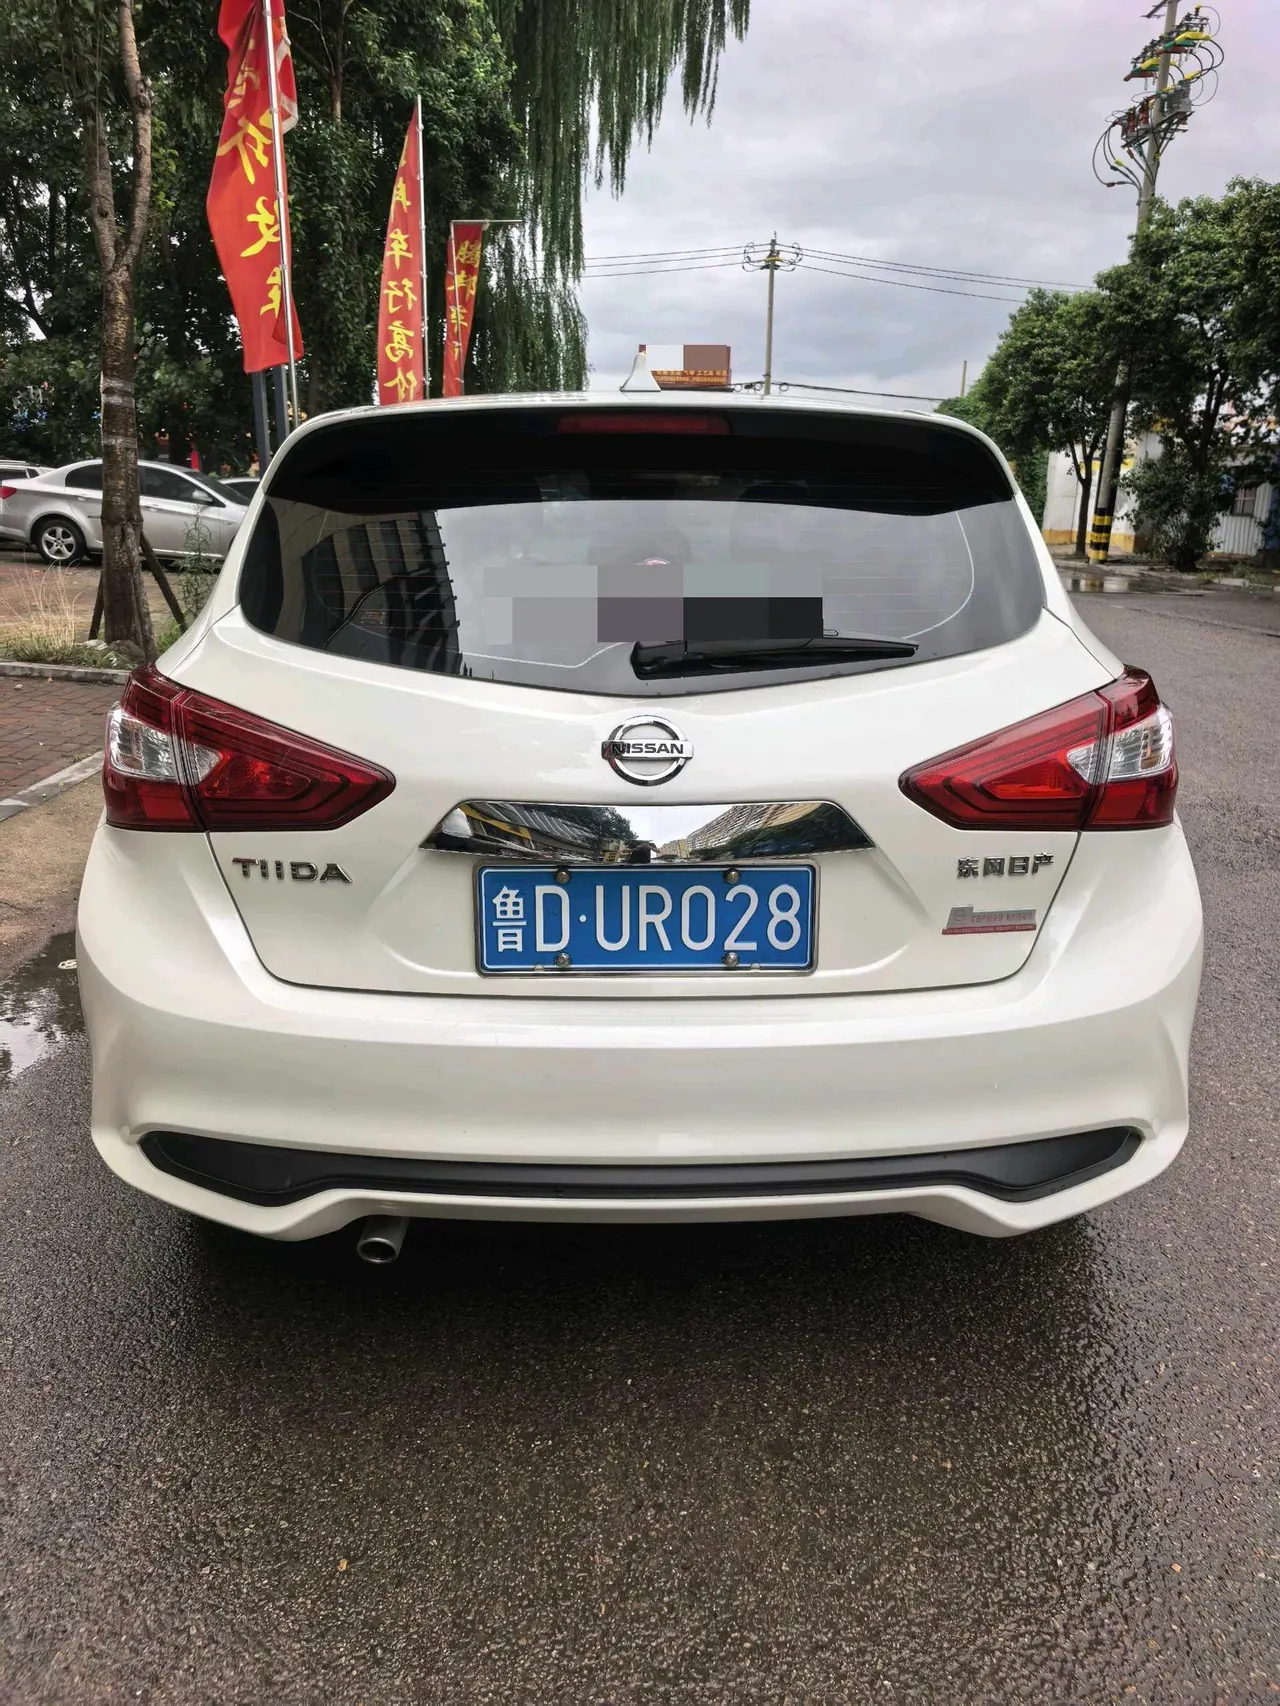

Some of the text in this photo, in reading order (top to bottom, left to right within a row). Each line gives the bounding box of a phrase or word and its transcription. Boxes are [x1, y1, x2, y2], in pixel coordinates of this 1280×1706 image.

[611, 742, 684, 755] NISSAN
[232, 857, 352, 883] TIIDA
[957, 852, 1054, 879] 东风日产
